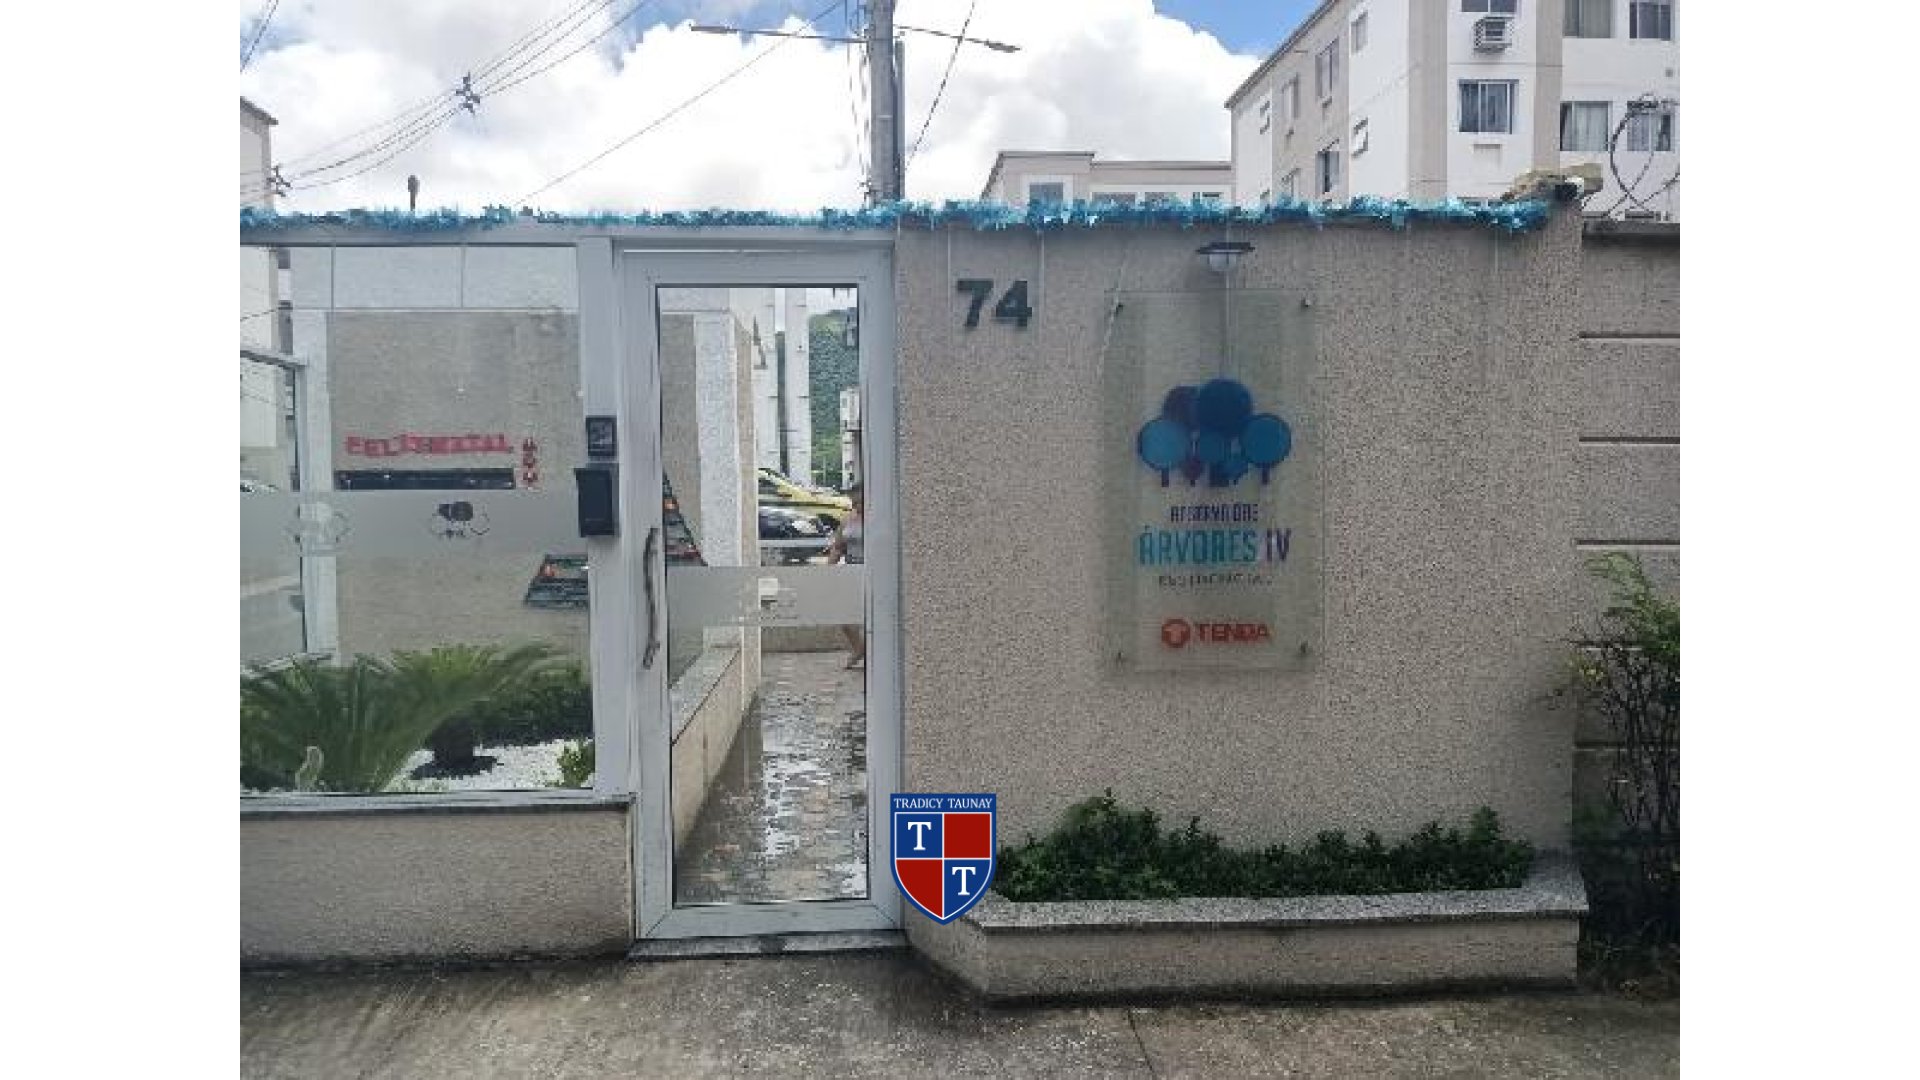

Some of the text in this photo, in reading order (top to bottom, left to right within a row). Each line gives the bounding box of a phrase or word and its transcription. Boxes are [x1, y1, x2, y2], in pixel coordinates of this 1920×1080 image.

[957, 278, 1033, 327] 74
[1137, 525, 1291, 565] ÁRVORES IV
[1196, 623, 1272, 642] TENDA
